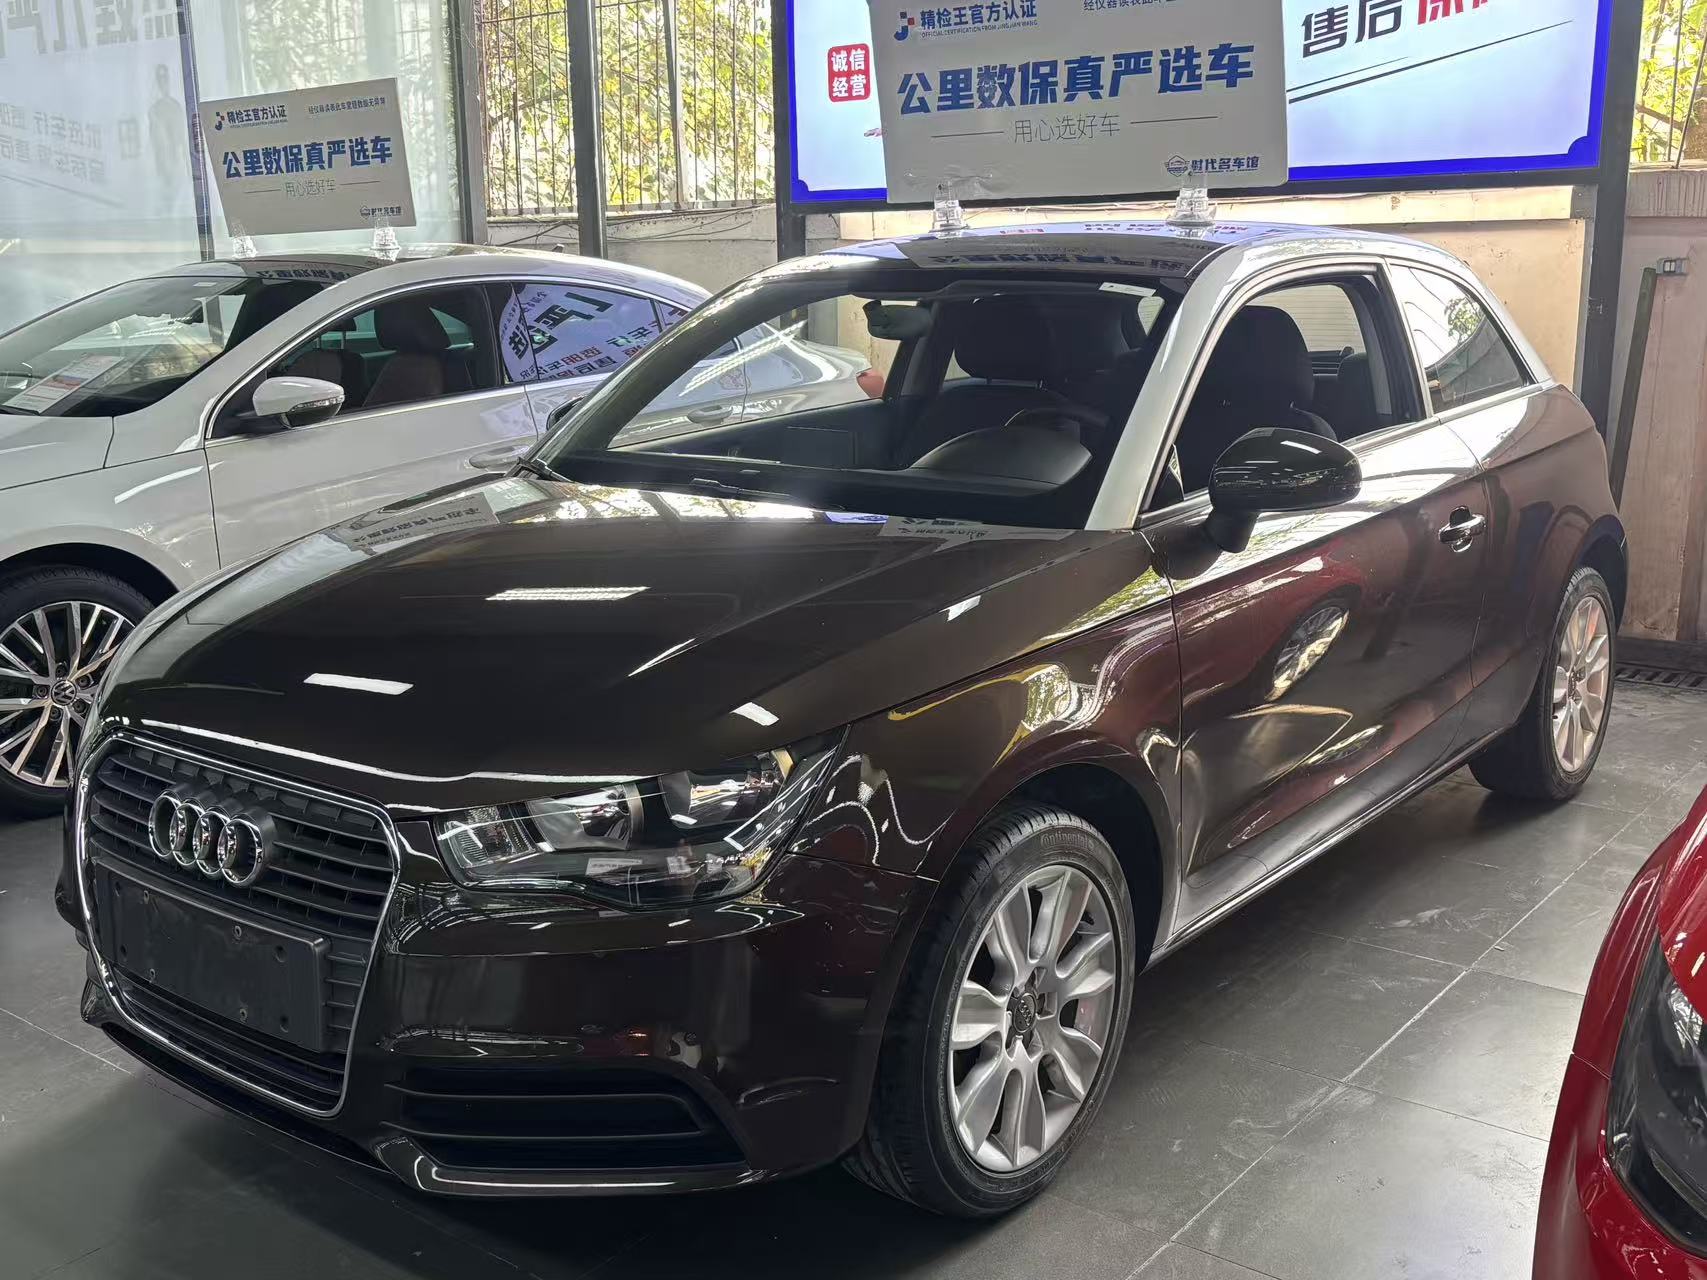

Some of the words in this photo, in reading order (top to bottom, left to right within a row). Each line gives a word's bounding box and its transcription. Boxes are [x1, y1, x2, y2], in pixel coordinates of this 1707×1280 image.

[920, 0, 1037, 29] 精检王官方认证
[921, 30, 943, 38] OFFICIAL
[831, 48, 866, 72] 诚信
[832, 74, 867, 97] 经营
[897, 43, 1255, 115] 公里数保真严选车
[227, 105, 288, 124] 精检王官方认证
[1013, 114, 1120, 143] 用心选好车
[223, 137, 393, 178] 公里数保真严选车
[1191, 156, 1259, 172] 时代名车馆
[285, 179, 336, 197] 用心选好车
